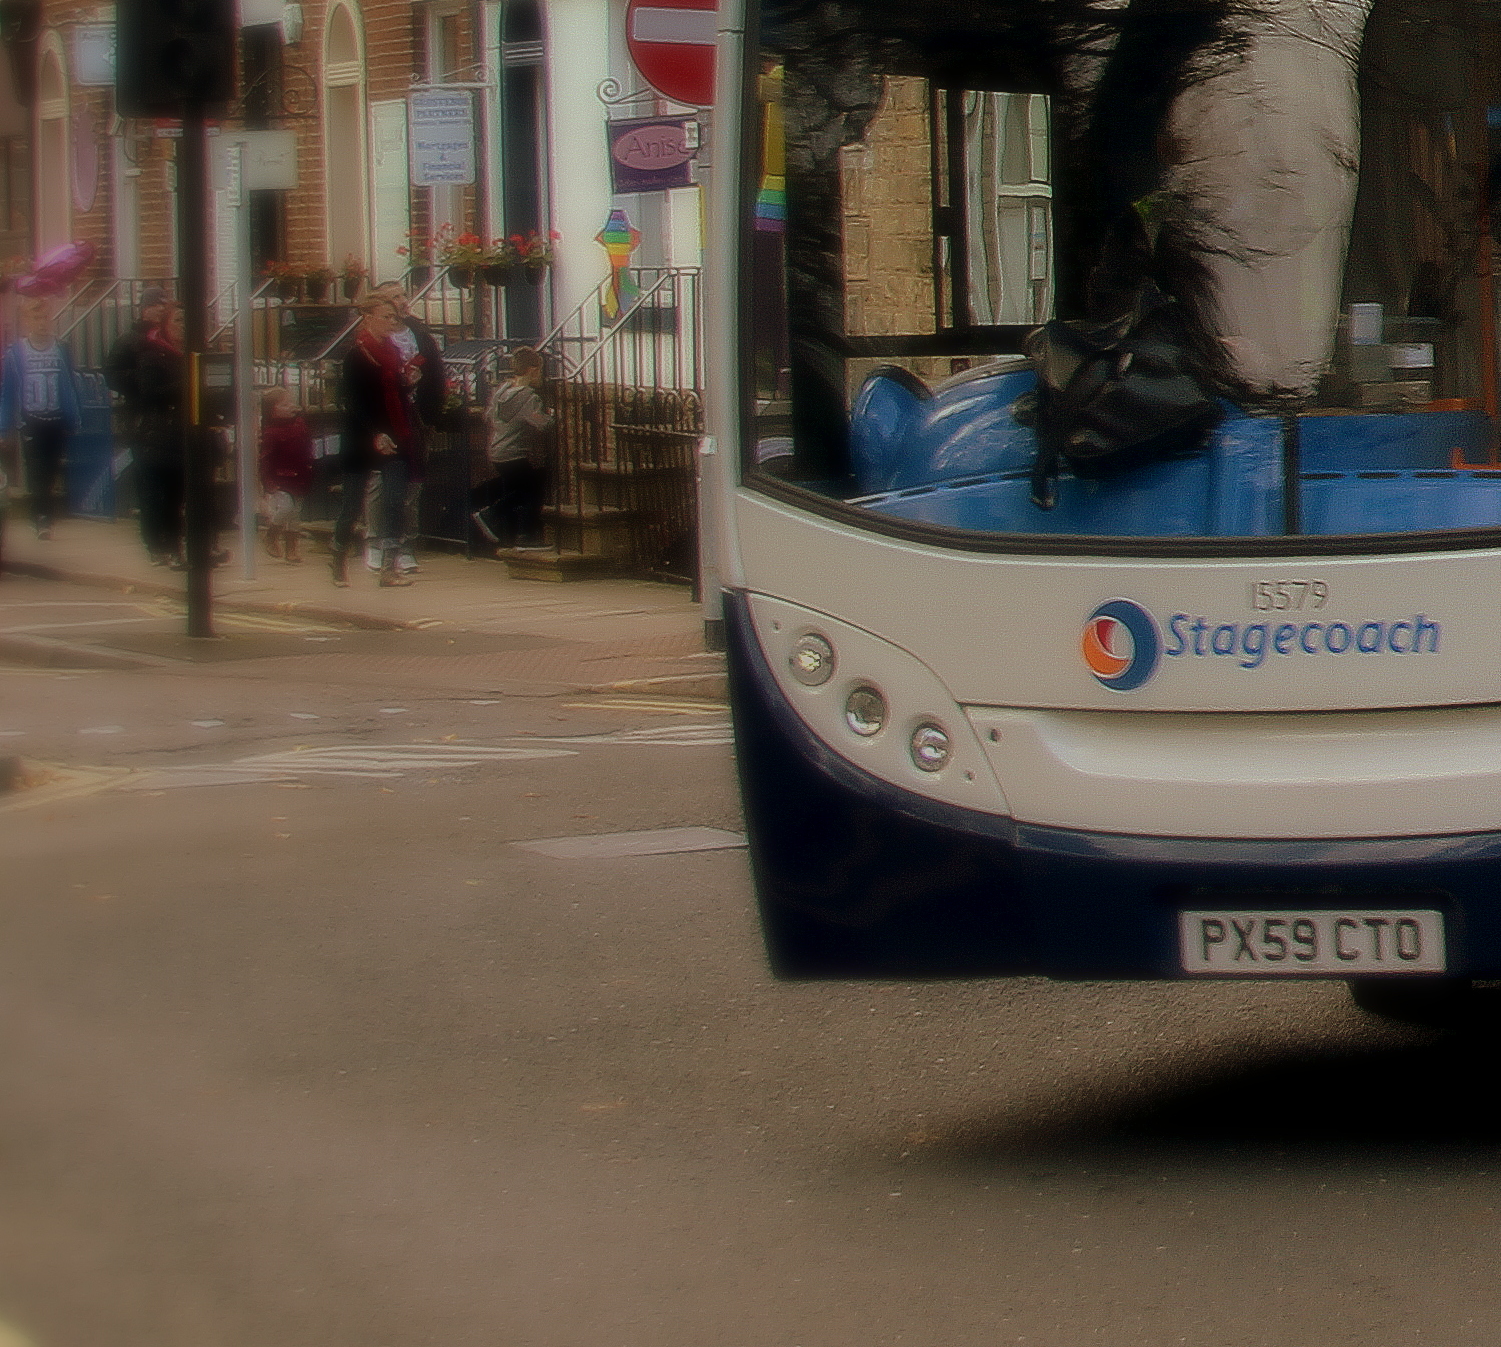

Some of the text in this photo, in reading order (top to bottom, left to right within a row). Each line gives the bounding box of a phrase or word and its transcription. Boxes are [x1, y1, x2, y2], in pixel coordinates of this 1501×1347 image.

[1251, 579, 1330, 611] 15579
[1165, 611, 1441, 668] Stagecoach
[1202, 918, 1422, 963] PX59 CTO
